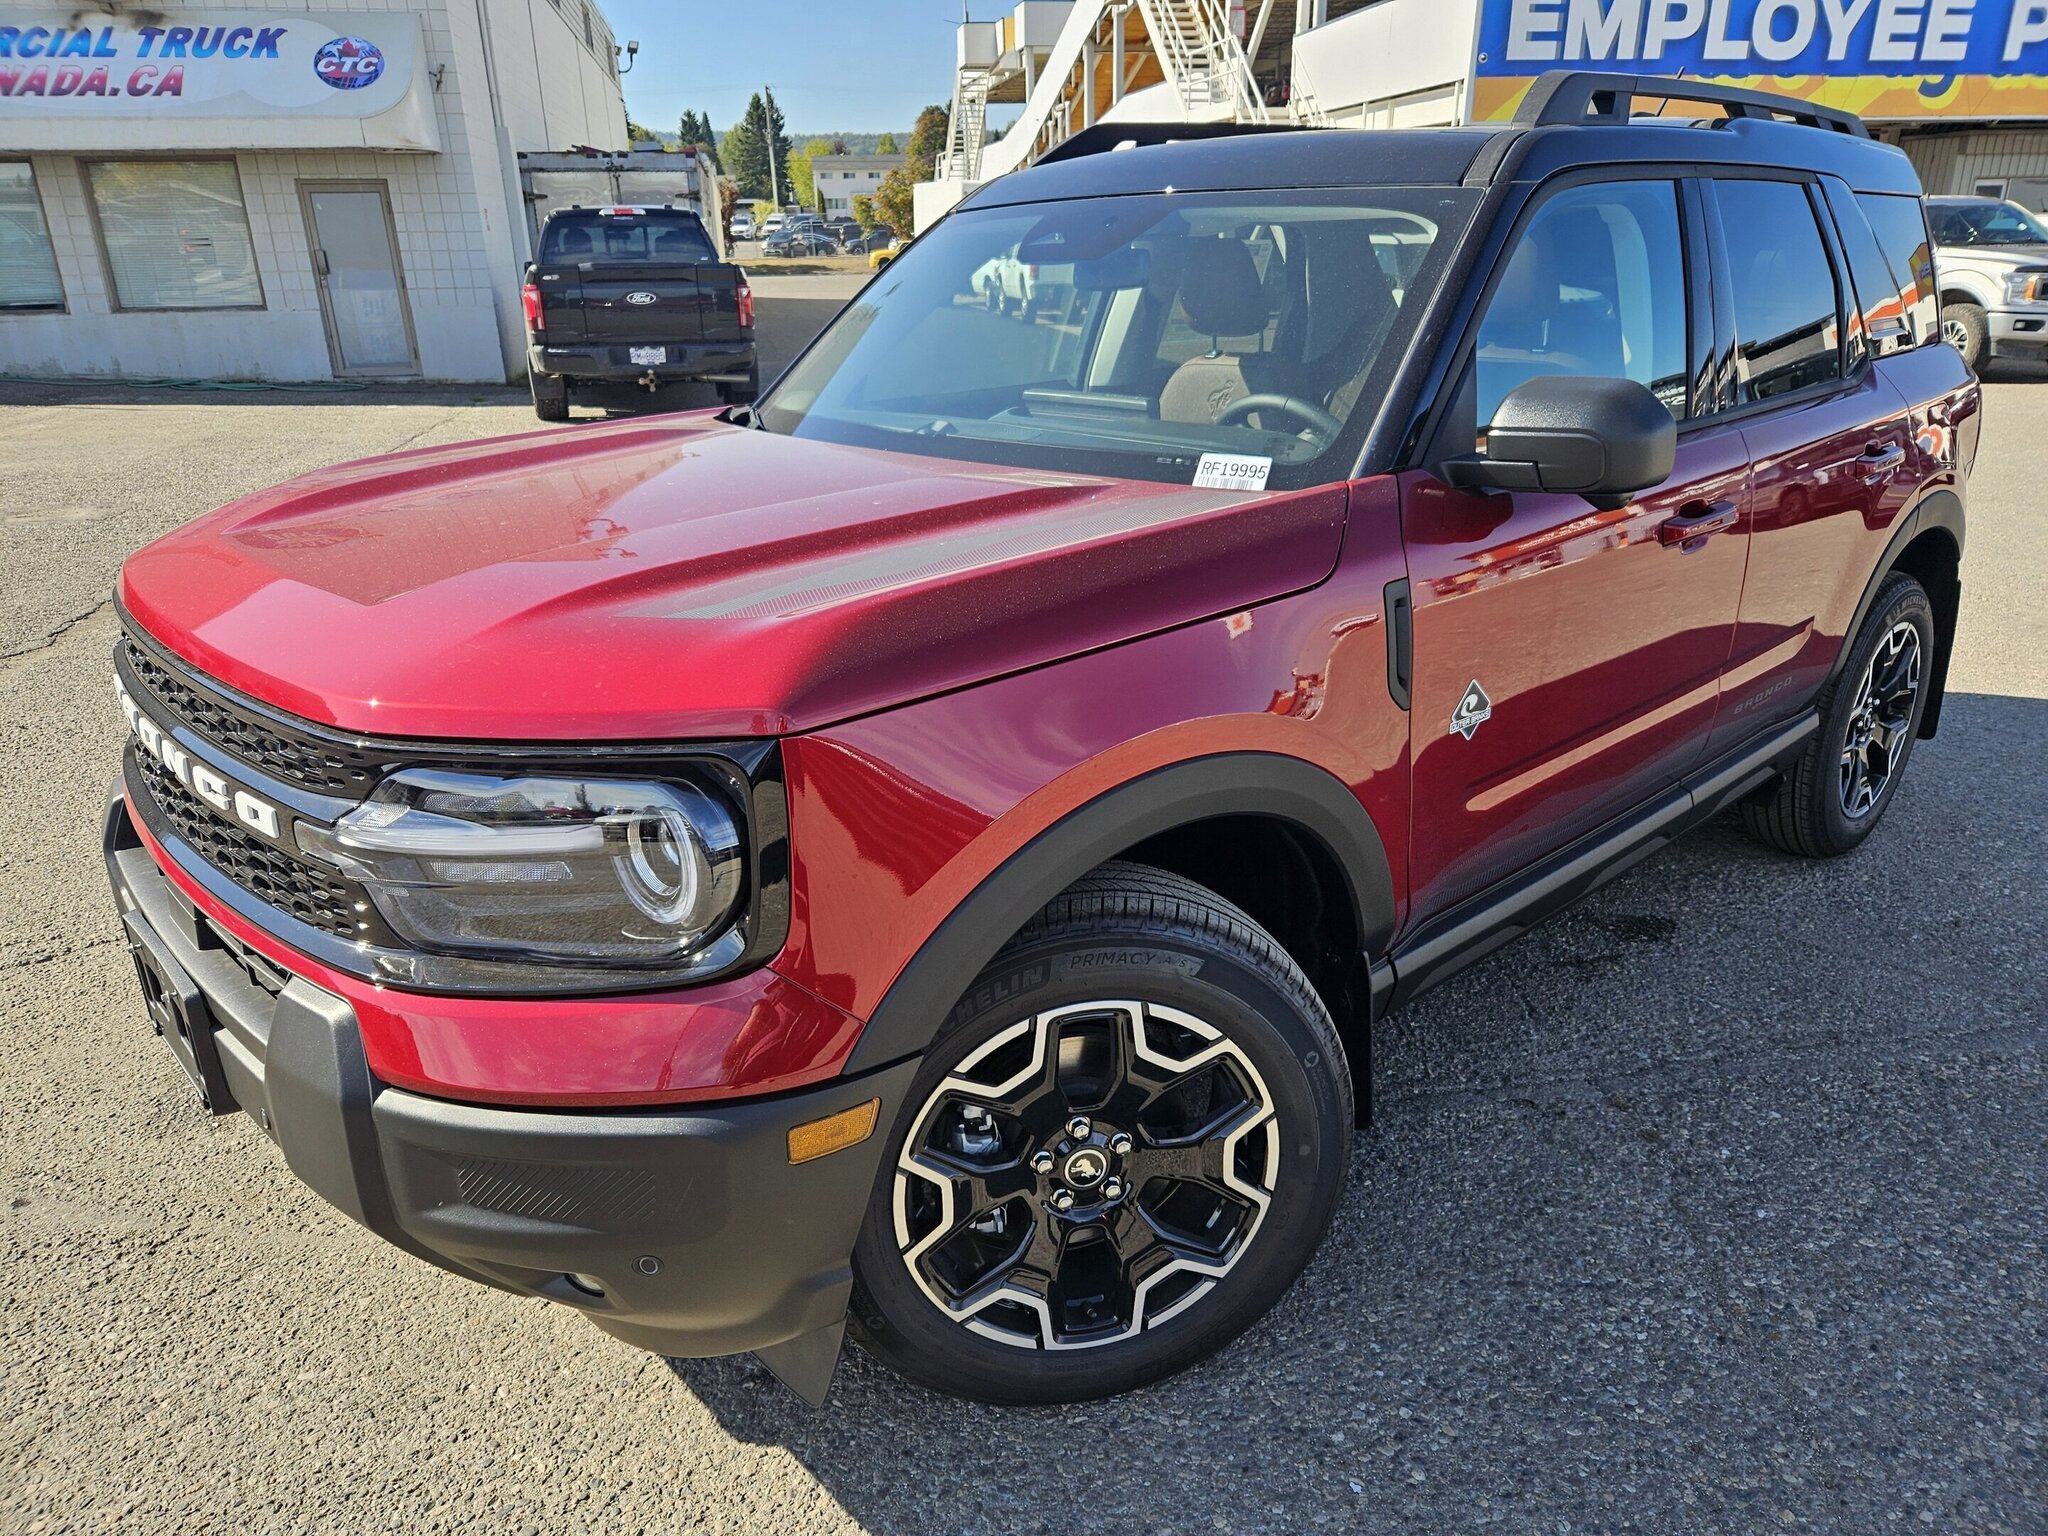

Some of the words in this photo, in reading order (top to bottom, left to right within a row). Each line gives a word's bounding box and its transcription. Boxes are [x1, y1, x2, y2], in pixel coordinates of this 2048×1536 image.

[1506, 0, 1974, 61] EMPLOYEE
[0, 26, 117, 58] RCIAL
[136, 27, 287, 59] TRUCK
[317, 56, 379, 73] CTC
[630, 292, 653, 304] Ford
[1200, 461, 1268, 480] RF19995
[1734, 676, 1793, 714] BRONCO
[1070, 951, 1157, 969] PRIMACY
